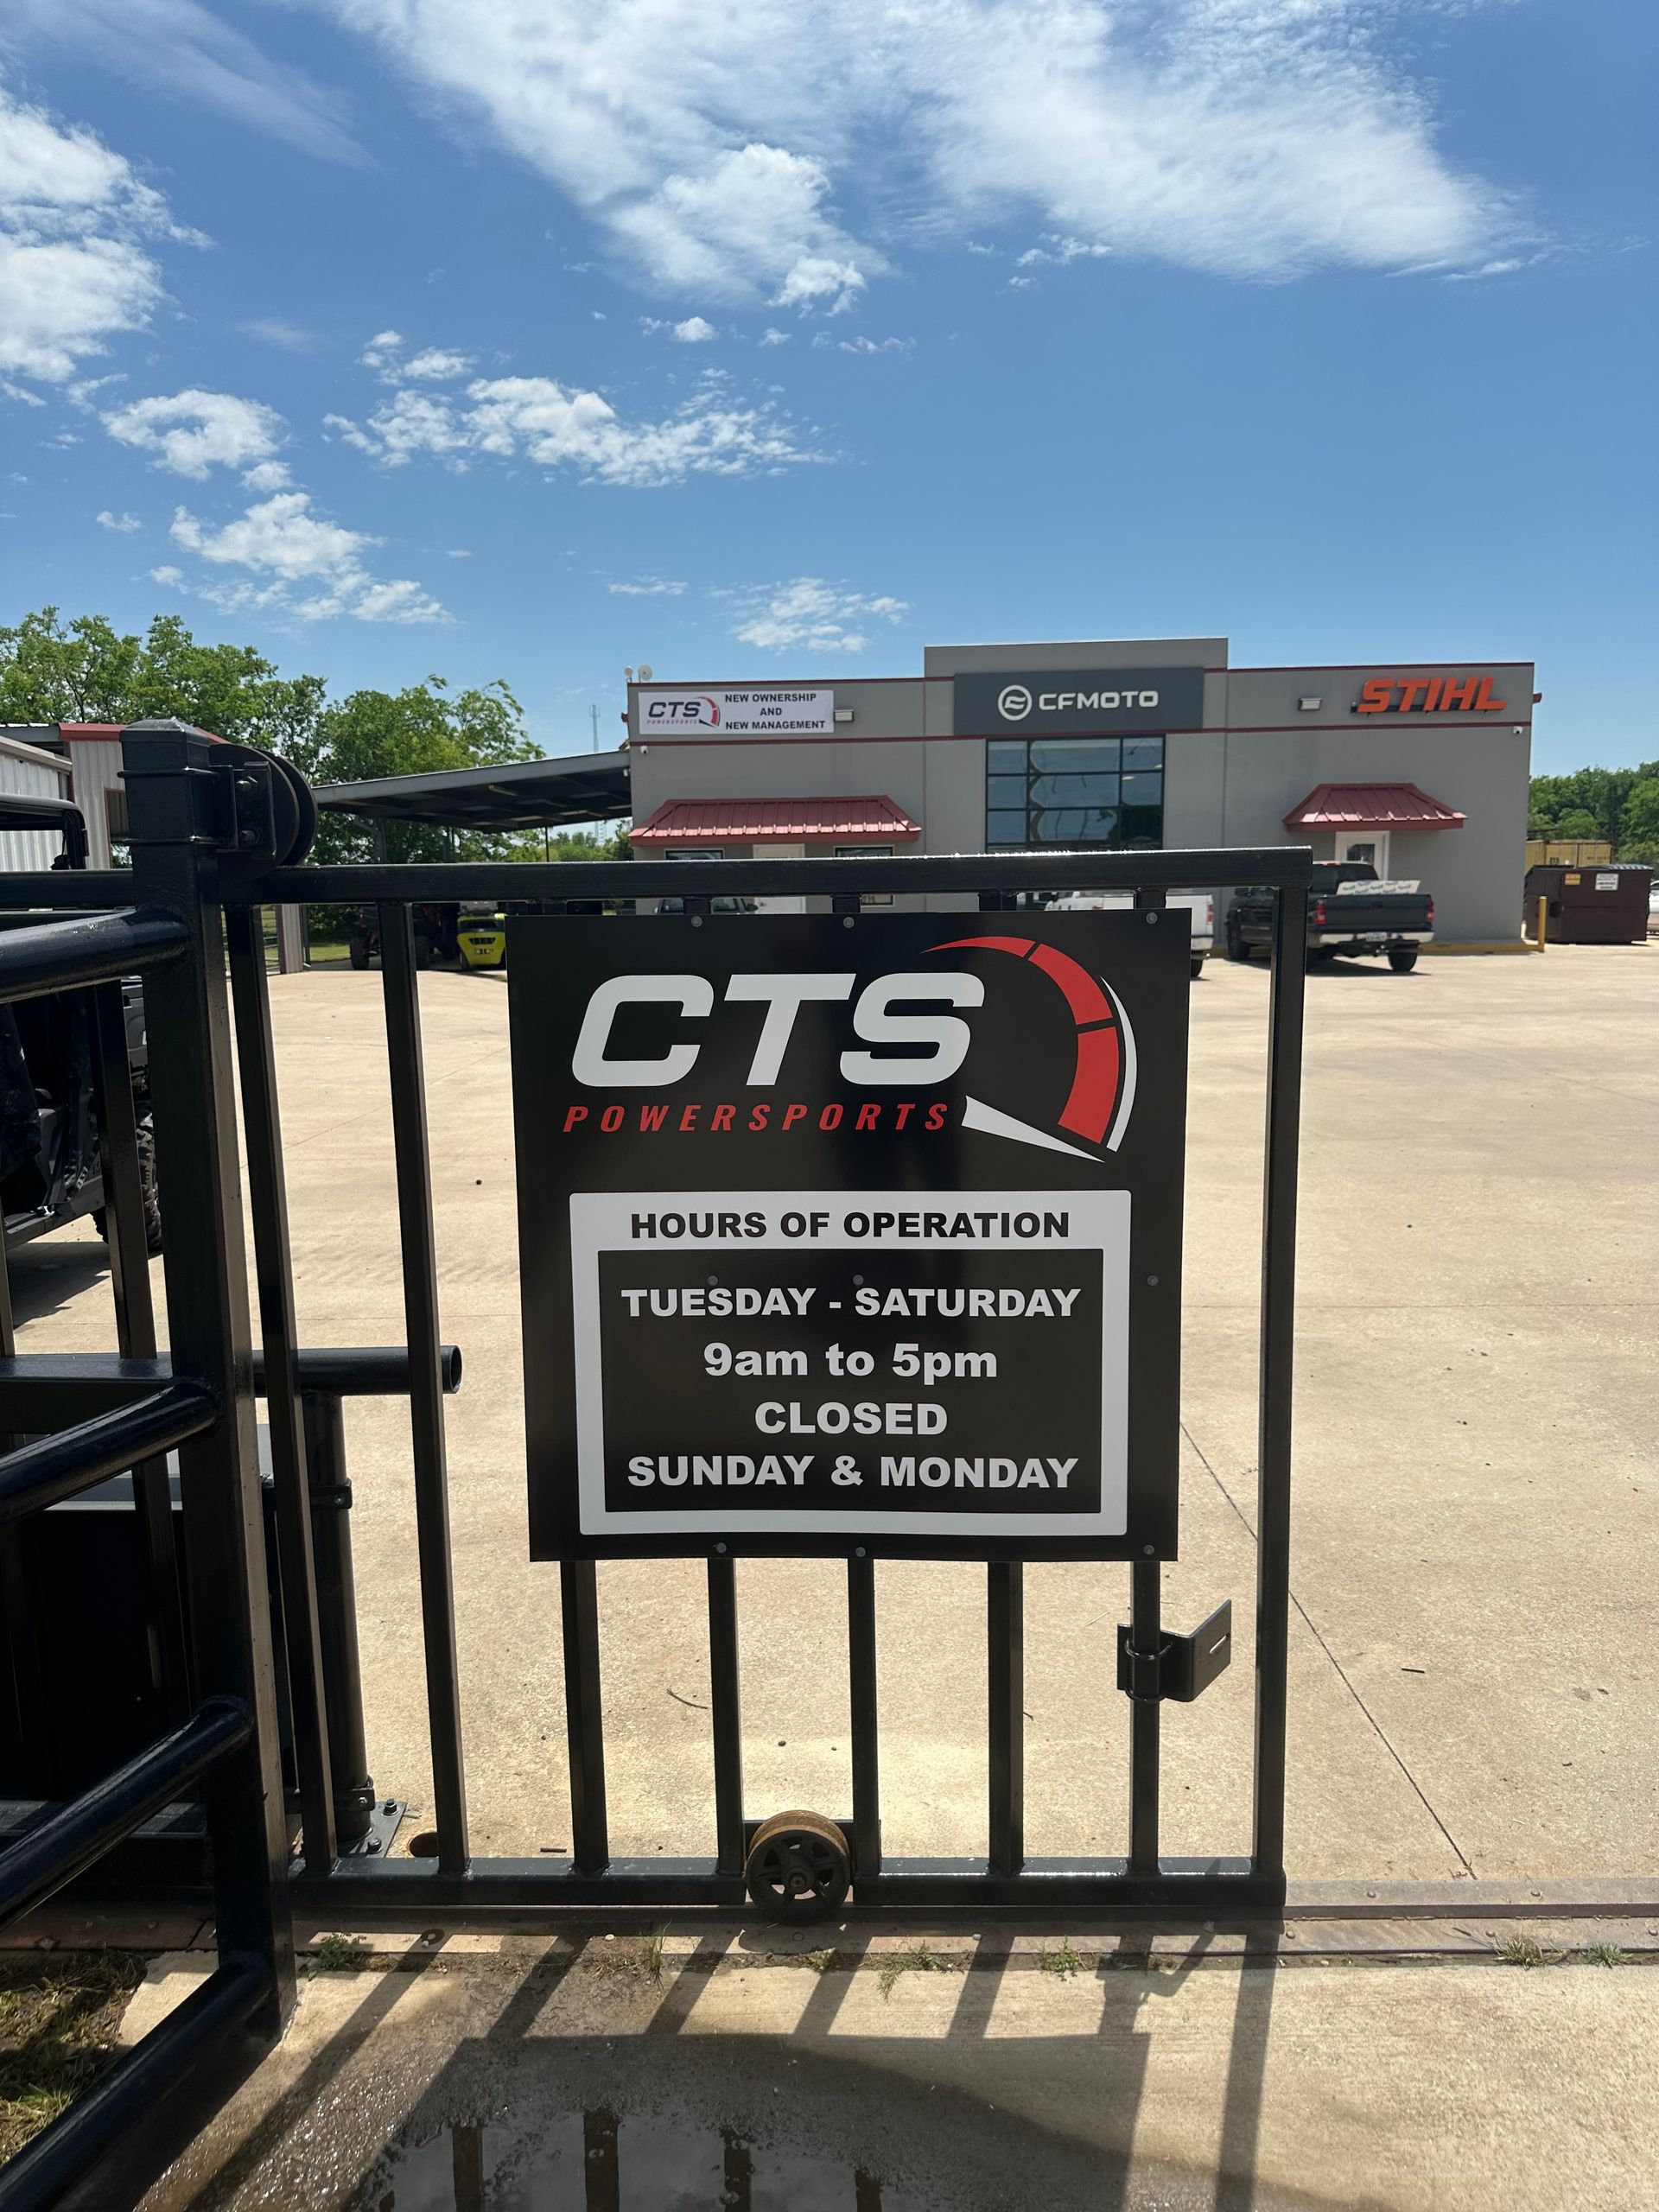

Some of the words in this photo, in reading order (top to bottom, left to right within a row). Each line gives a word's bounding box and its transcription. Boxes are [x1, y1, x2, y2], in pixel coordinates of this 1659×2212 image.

[648, 702, 701, 718] CTS
[725, 694, 749, 702] NEW
[753, 693, 817, 702] OWNERSHIP
[1039, 690, 1159, 710] CFMOTO
[1357, 677, 1507, 713] STIHL
[726, 721, 749, 730] NEW
[752, 719, 826, 730] MANAGEMENT
[760, 708, 782, 716] AND
[572, 973, 984, 1086] CTS
[563, 1103, 948, 1133] POWERSPORTS
[631, 1212, 766, 1238] HOURS
[780, 1212, 830, 1238] OF
[843, 1211, 1070, 1238] OPERATION
[621, 1288, 817, 1317] TUESDAY
[829, 1301, 842, 1310] -
[855, 1288, 1081, 1318] SATURDAY
[703, 1343, 808, 1376] 9am
[825, 1343, 874, 1376] to
[892, 1343, 997, 1386] 5pm
[754, 1402, 948, 1435] CLOSED
[627, 1455, 815, 1487] SUNDAY
[830, 1455, 864, 1487] &
[880, 1456, 1079, 1488] MONDAY
